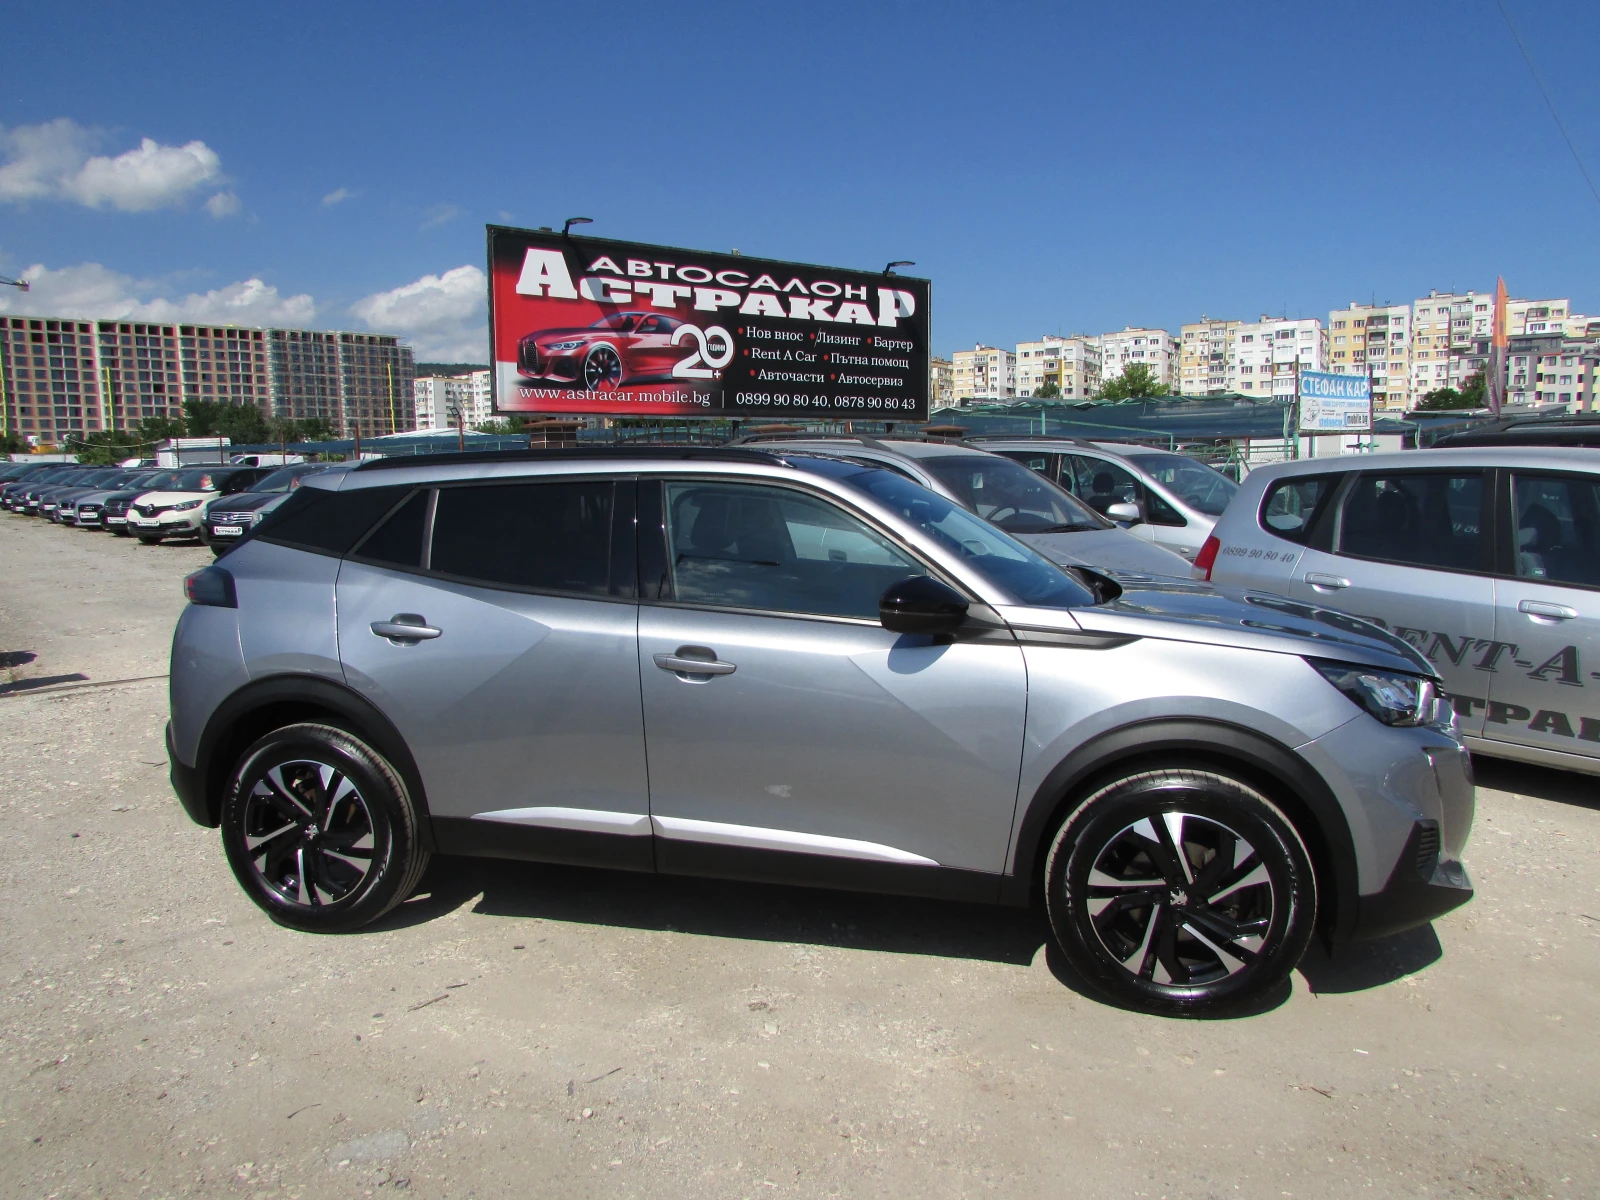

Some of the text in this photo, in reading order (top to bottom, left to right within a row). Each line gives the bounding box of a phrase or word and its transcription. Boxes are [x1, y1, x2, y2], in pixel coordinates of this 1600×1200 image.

[586, 256, 867, 301] АВТОСАЛОН
[516, 248, 915, 327] АСТРАКАР
[746, 327, 804, 341] Нов внос
[817, 332, 861, 346] Лизинг
[874, 337, 913, 352] Бартер
[751, 348, 817, 362] Rent A Car
[830, 353, 909, 369] Пътна помощ
[758, 369, 824, 382] Авточасти
[837, 373, 903, 388] Автосервиз
[1301, 376, 1368, 397] СТЕФАН КАР
[518, 386, 711, 407] www.astracar.mobile.bg
[736, 393, 916, 410] 0899 90 80 40, 0878 90 80 43
[1222, 546, 1295, 563] 0899 90 80 40
